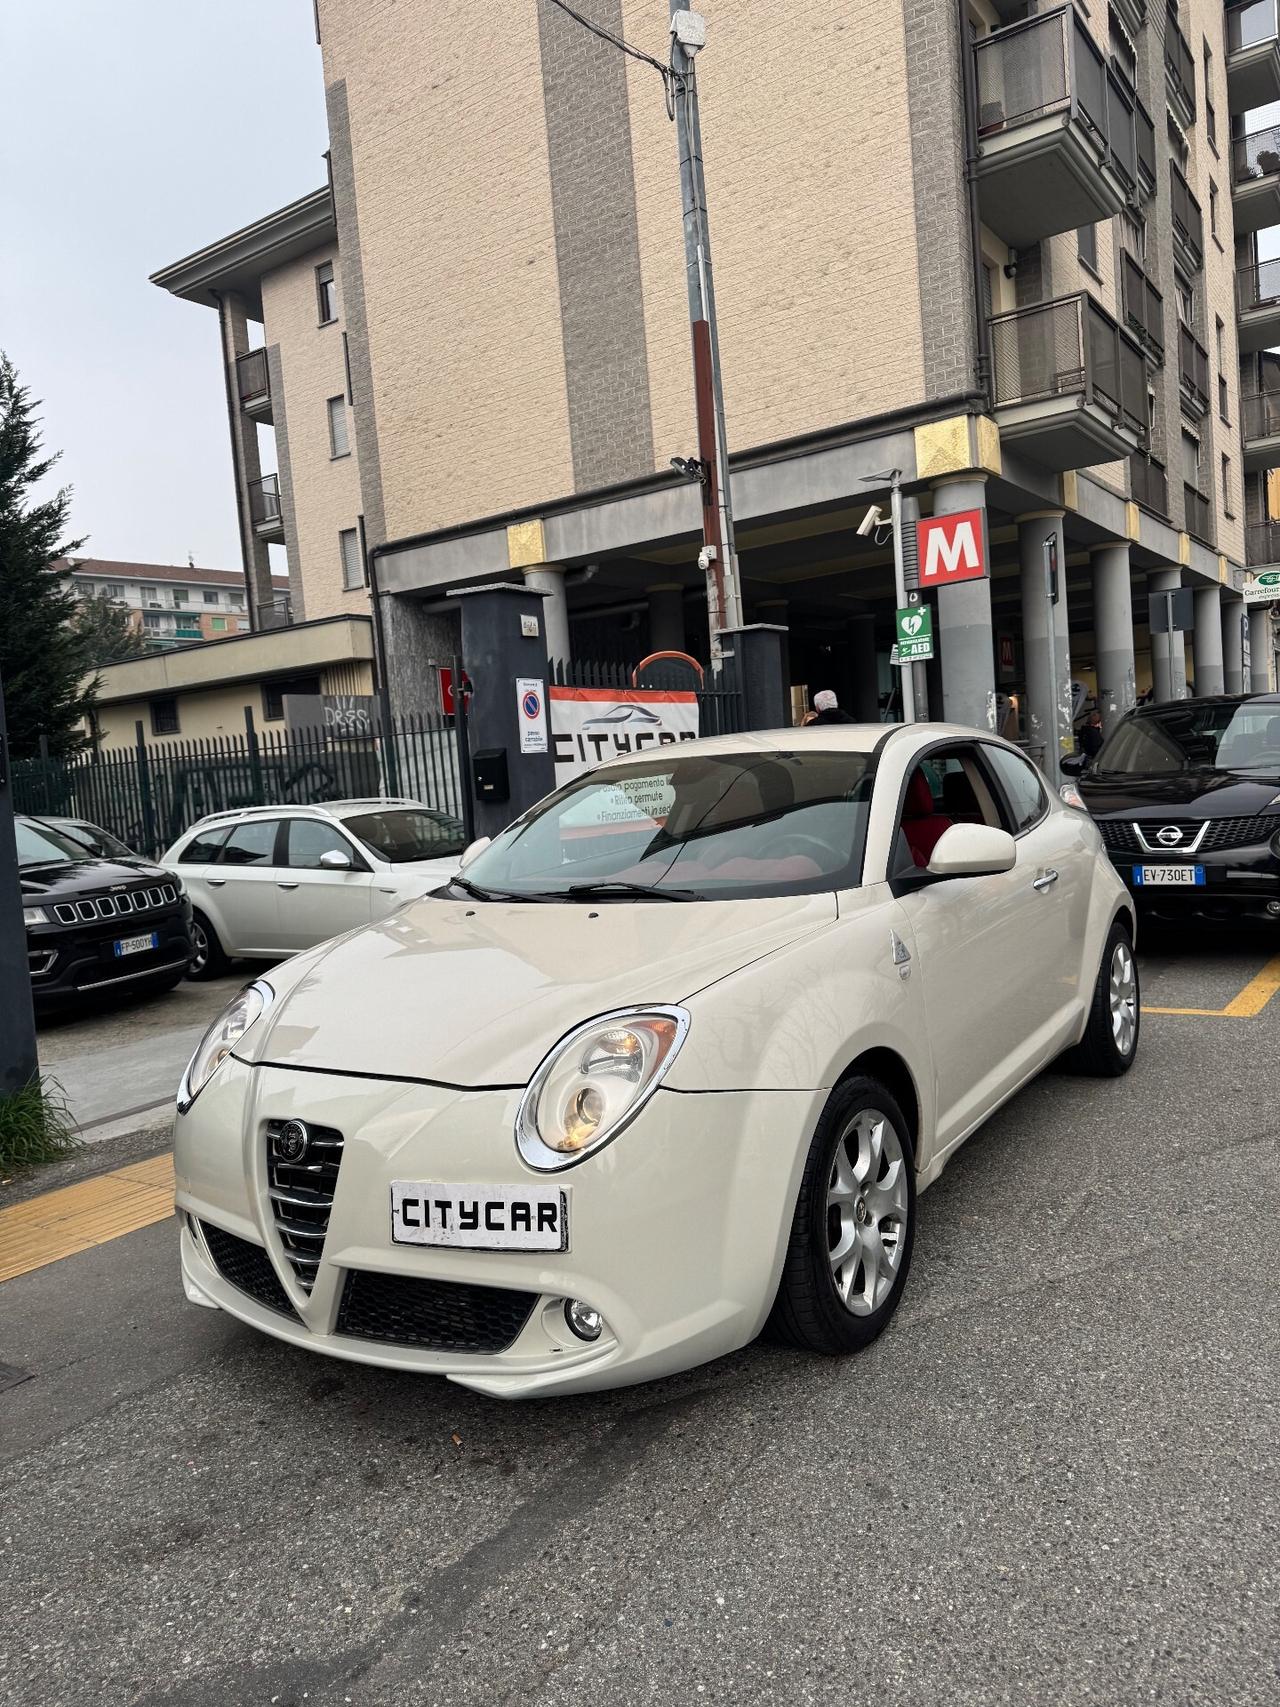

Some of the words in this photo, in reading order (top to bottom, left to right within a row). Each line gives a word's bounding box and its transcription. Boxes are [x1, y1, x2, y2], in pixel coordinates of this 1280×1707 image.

[925, 521, 979, 576] M
[1244, 587, 1280, 597] Carrefour
[911, 642, 930, 654] AED
[624, 778, 665, 794] pagamento
[634, 790, 663, 805] permute
[402, 1198, 558, 1232] CITYCAR
